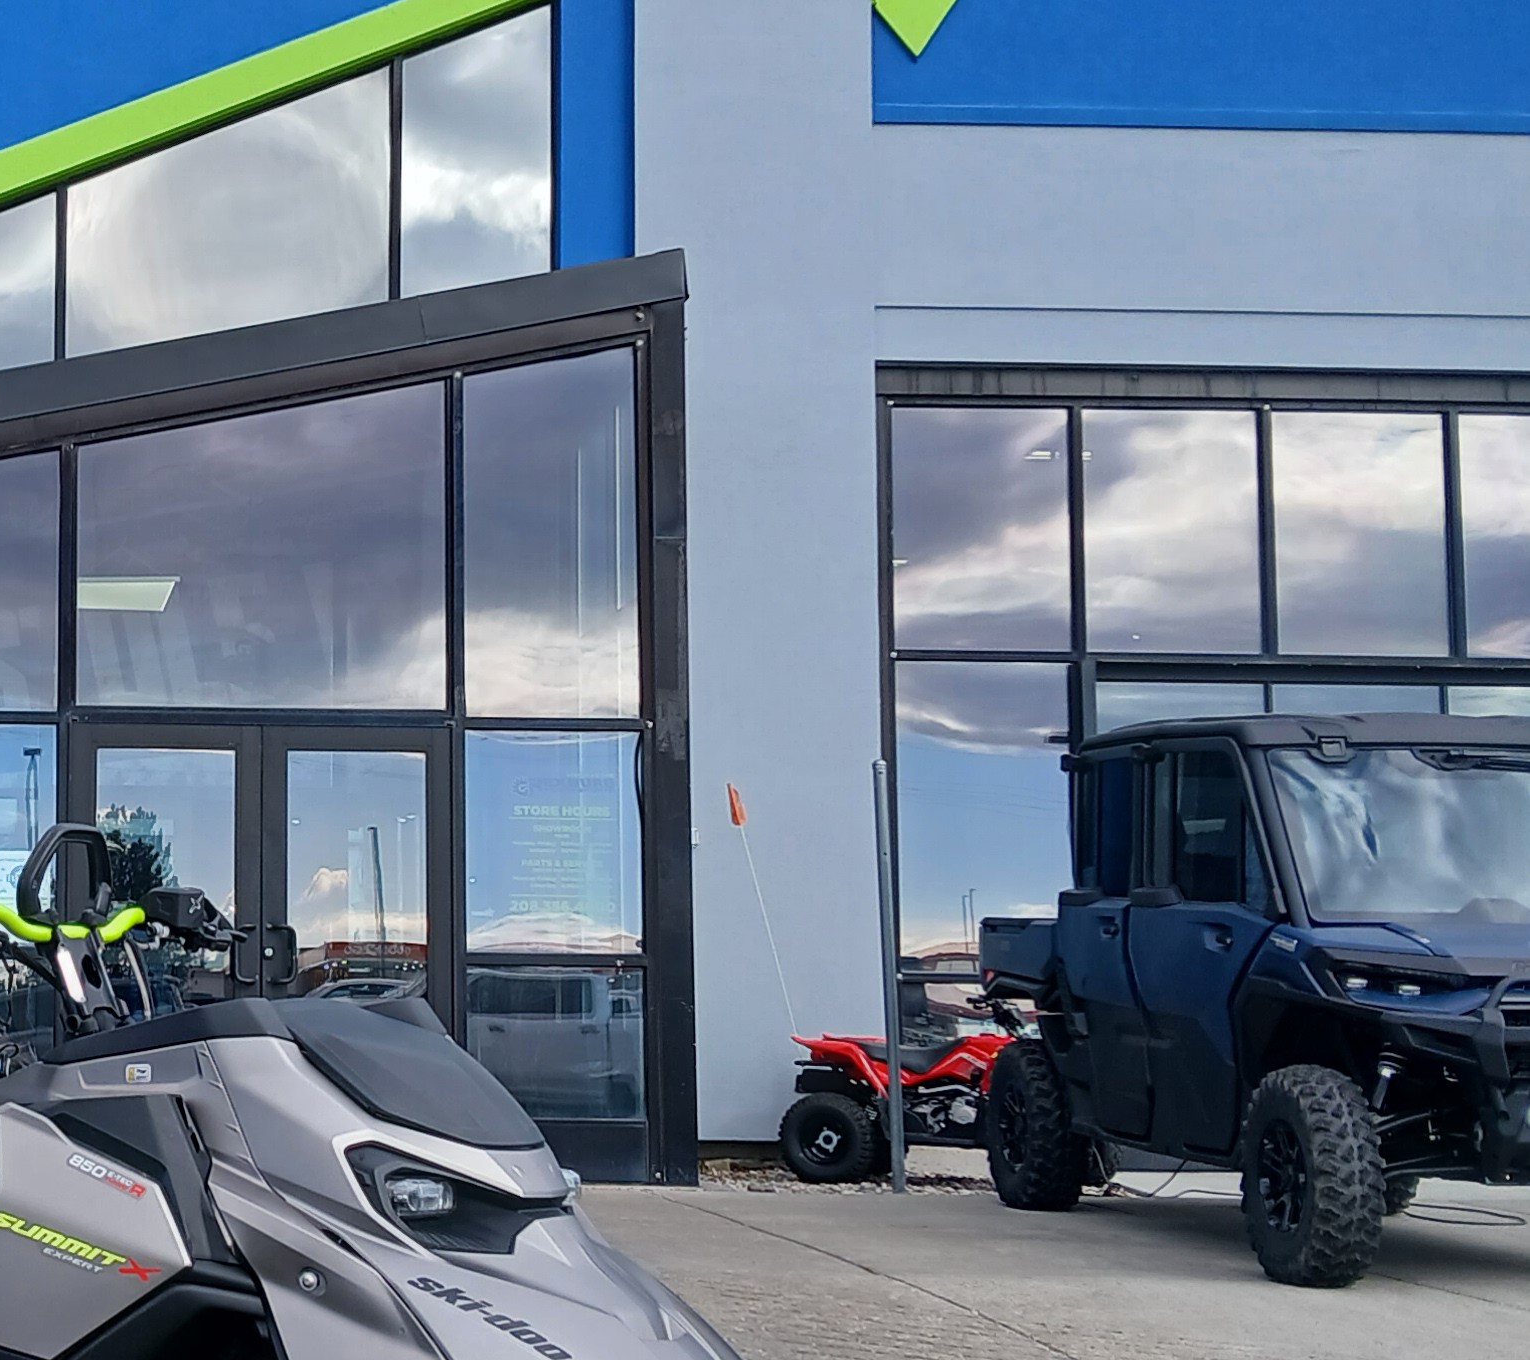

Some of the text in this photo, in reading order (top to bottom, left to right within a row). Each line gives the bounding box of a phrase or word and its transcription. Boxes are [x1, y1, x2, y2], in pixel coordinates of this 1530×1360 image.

[513, 805, 610, 817] STORE HOURS
[67, 1152, 108, 1179] 850
[41, 1246, 105, 1274] EXPERT
[118, 1256, 162, 1282] X
